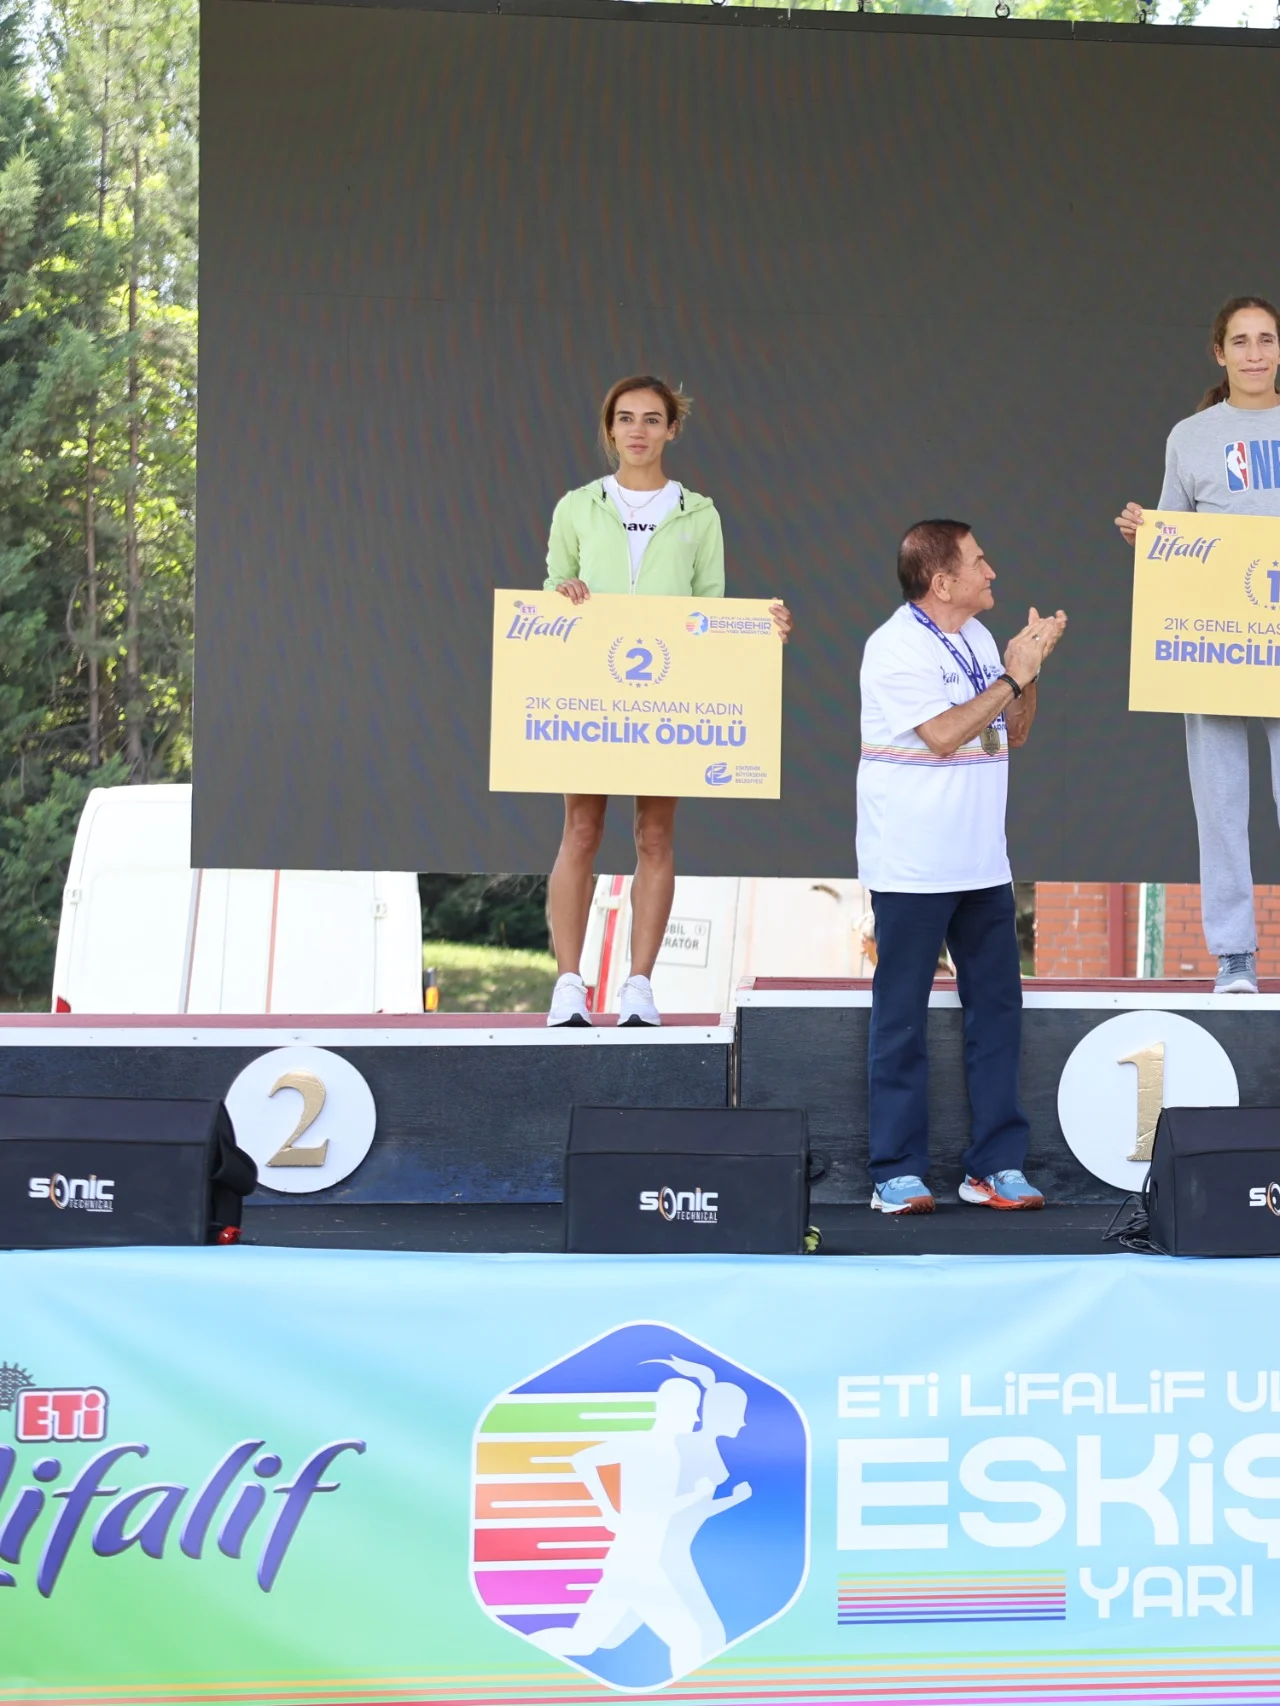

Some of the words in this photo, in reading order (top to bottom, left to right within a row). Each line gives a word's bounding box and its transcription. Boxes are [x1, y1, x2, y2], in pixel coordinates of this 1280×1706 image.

[1147, 535, 1222, 565] Lifalif
[1266, 569, 1280, 604] 1
[506, 614, 583, 643] Lifalif
[1163, 616, 1189, 631] 21K
[1193, 618, 1243, 634] GENEL
[625, 647, 653, 681] 2
[525, 696, 551, 711] 21K
[556, 697, 608, 713] GENEL
[612, 699, 691, 715] KLASMAN
[695, 702, 744, 717] KADIN
[525, 713, 651, 744] İKİNCİLİK
[655, 717, 748, 747] ÖDÜLÜ
[264, 1069, 330, 1167] 2
[1116, 1041, 1165, 1162] 1
[68, 1199, 114, 1211] TECHNICAL
[676, 1211, 718, 1221] TECHNICAL
[0, 1438, 367, 1598] ifalif
[1079, 1564, 1254, 1619] YARI
